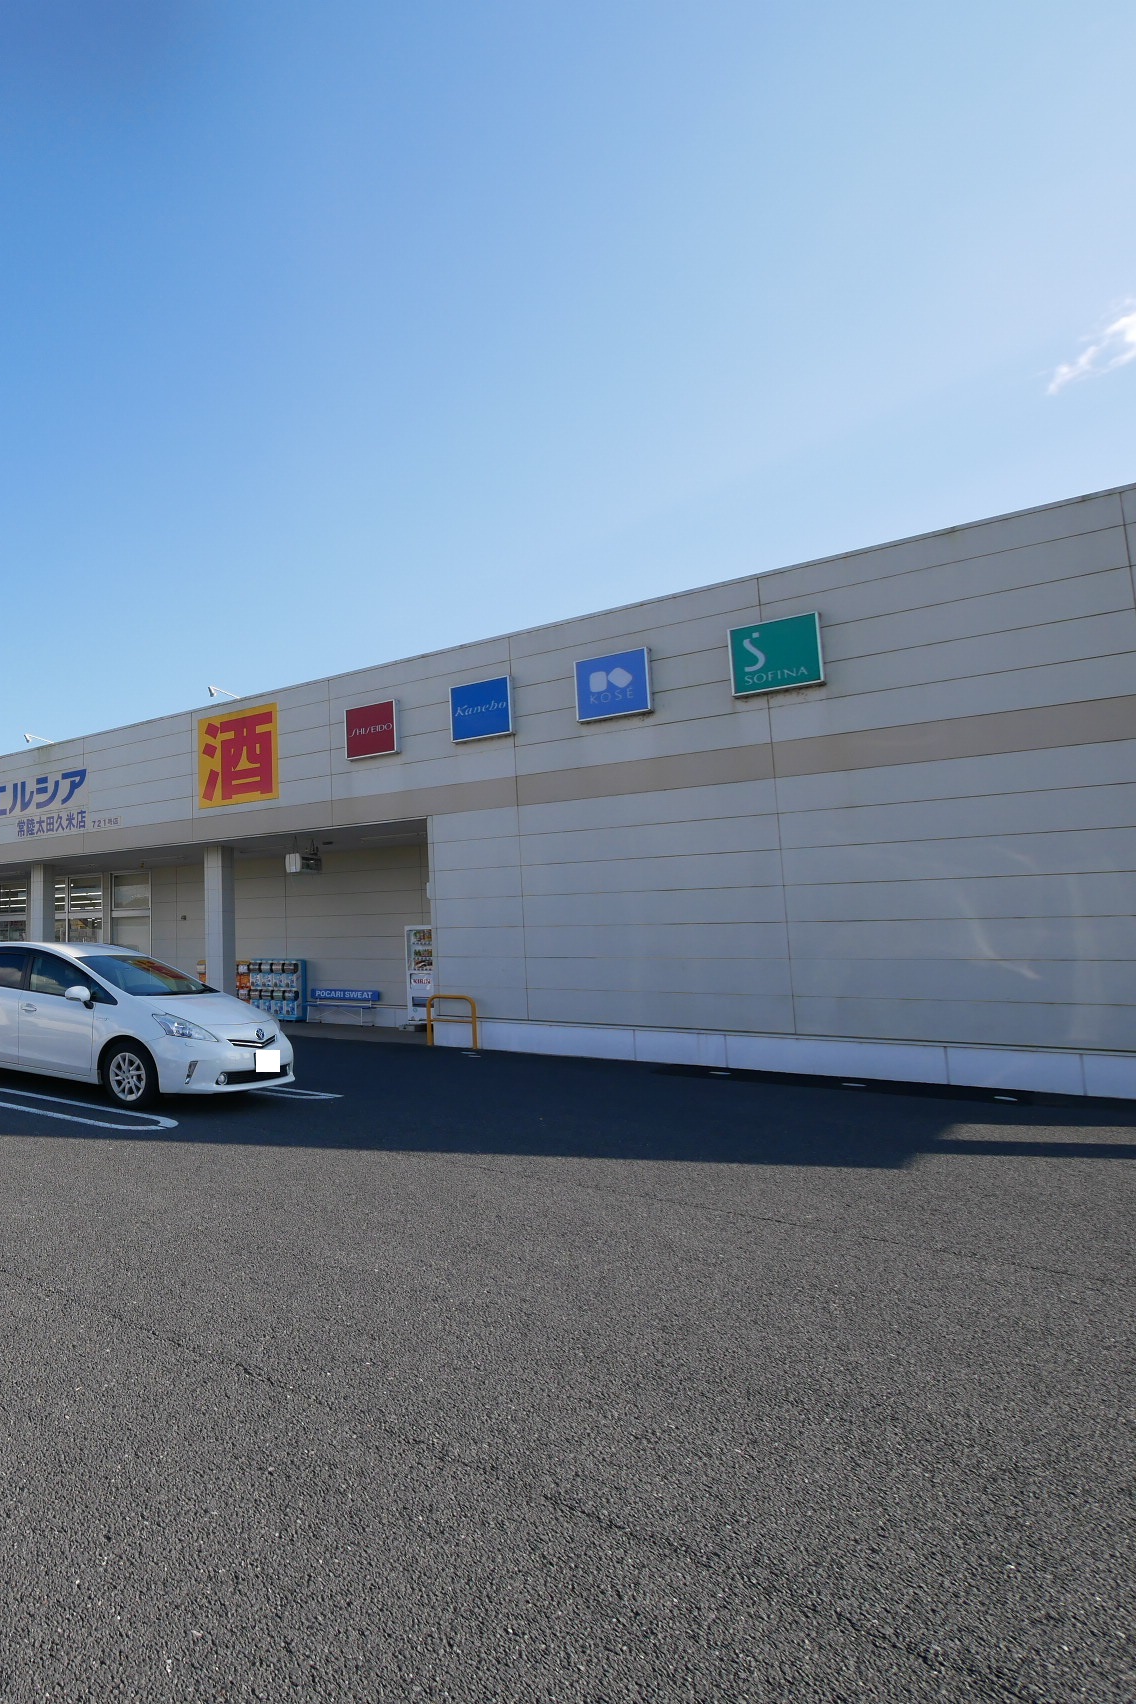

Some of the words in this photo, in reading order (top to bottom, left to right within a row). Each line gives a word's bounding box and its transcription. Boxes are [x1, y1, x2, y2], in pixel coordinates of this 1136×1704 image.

[745, 666, 809, 686] SOFINA
[454, 699, 507, 717] Kanebo
[348, 722, 393, 738] SHISEIDO
[202, 710, 273, 802] 酒
[16, 809, 87, 838] 常陸太田久米店
[315, 990, 344, 998] POCARI
[345, 990, 373, 999] SWEAT
